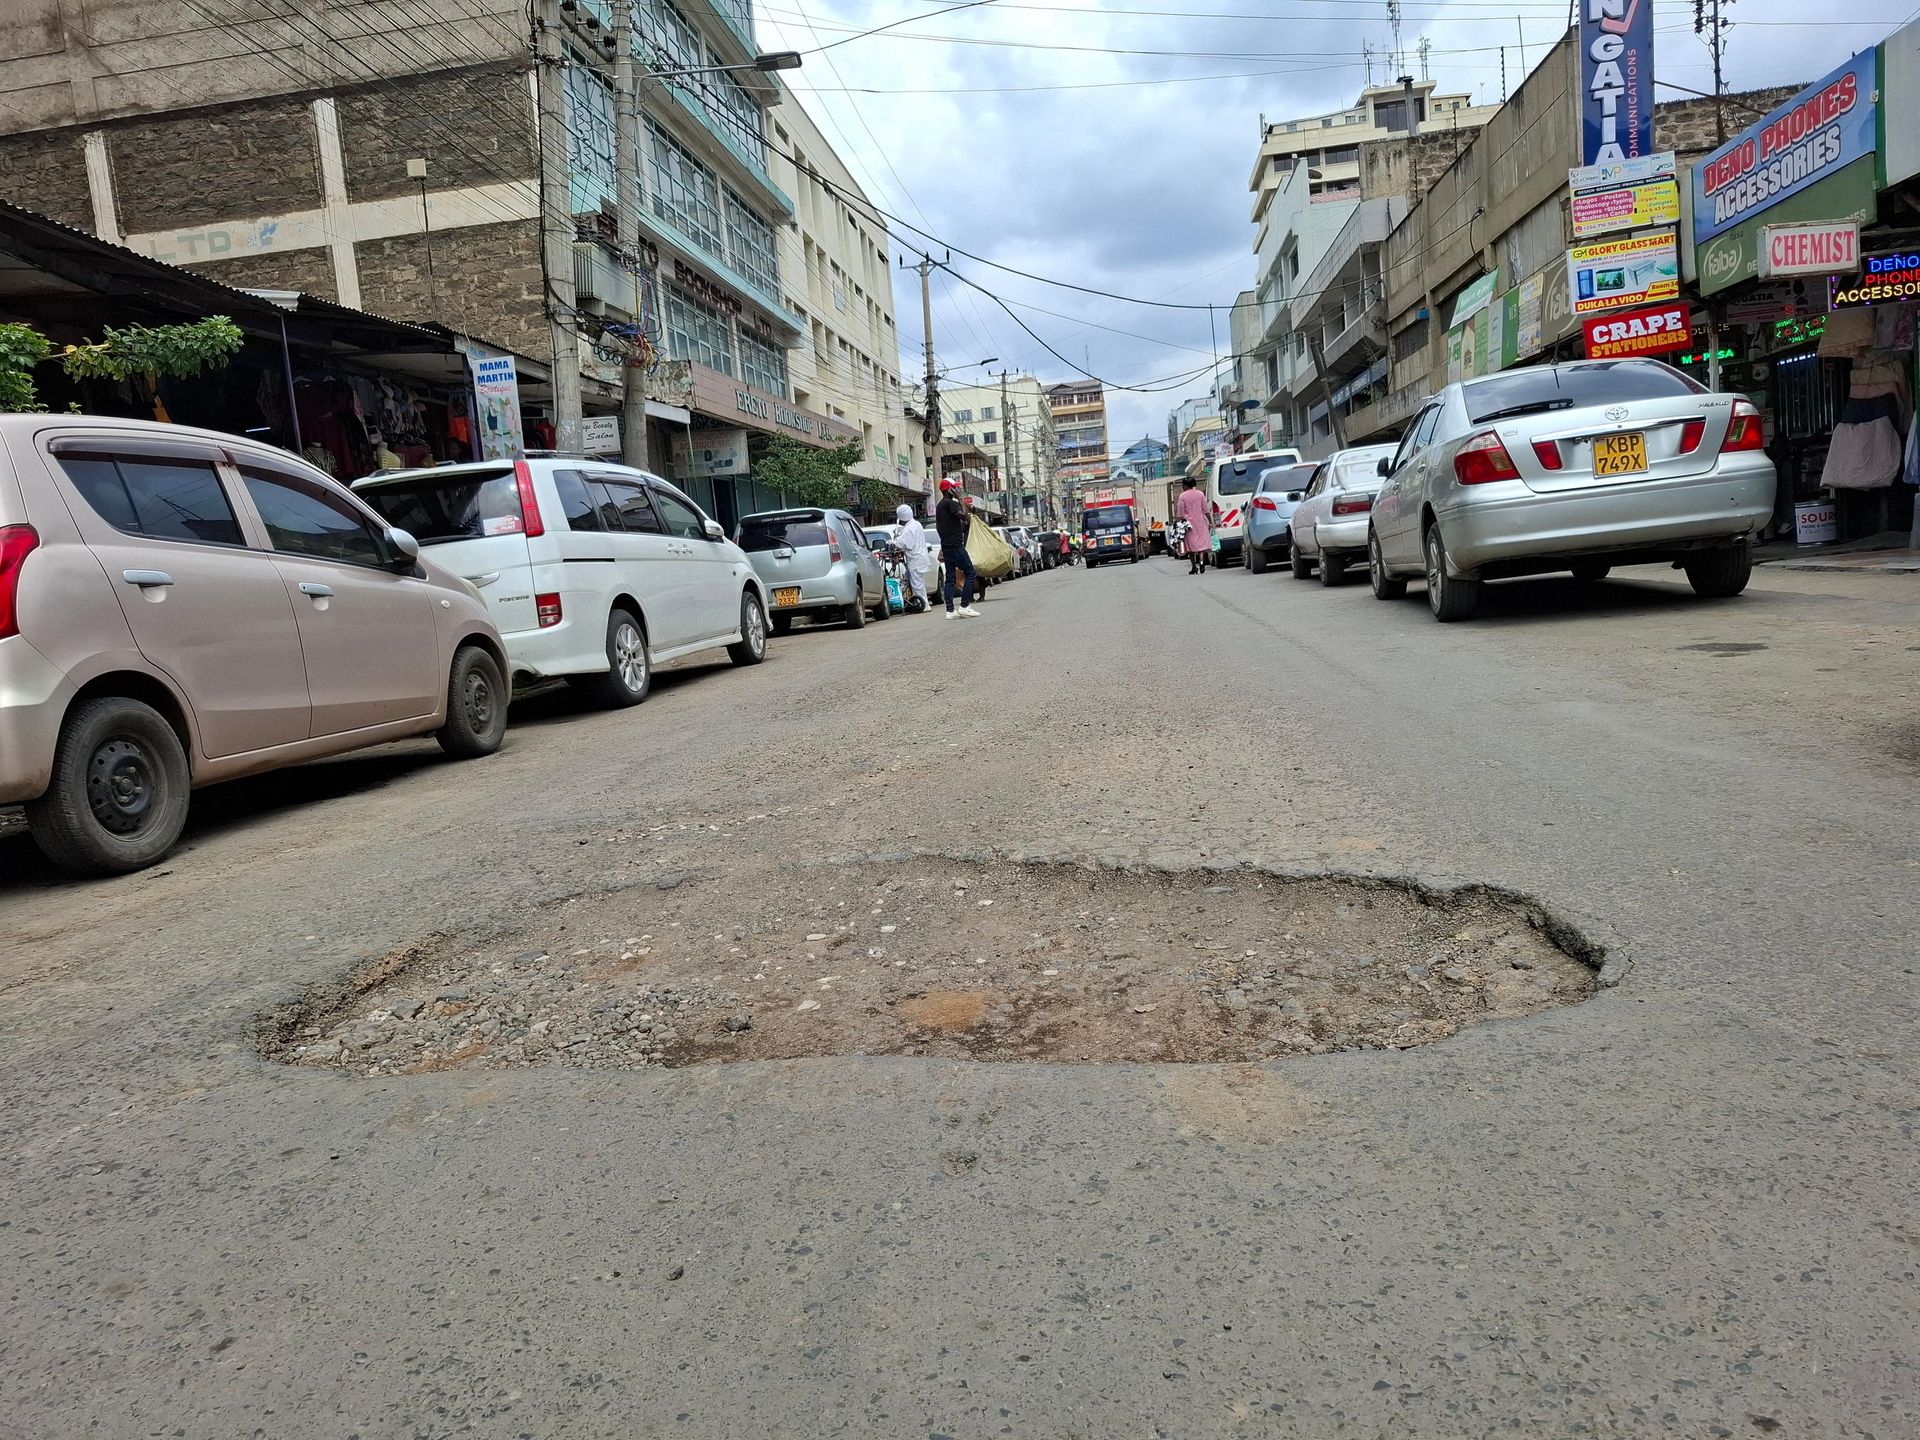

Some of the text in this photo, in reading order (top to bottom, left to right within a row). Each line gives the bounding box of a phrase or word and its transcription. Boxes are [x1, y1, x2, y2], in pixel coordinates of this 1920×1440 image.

[1626, 48, 1639, 159] OMMUNICATIONS
[1703, 72, 1857, 197] DENO PHONES
[1714, 125, 1841, 225] ACCESSORIES
[1576, 201, 1610, 211] Photocopy
[1579, 192, 1628, 205] Logos Posters
[1581, 213, 1609, 222] Business
[150, 230, 232, 261] LTD
[1588, 245, 1617, 257] GLORY
[1619, 240, 1648, 252] GLASS
[1649, 235, 1675, 247] MART
[1771, 230, 1855, 268] CHEMIST
[1870, 255, 1920, 273] DENO
[1836, 282, 1920, 304] ACCESSO
[1577, 301, 1602, 311] DUKA
[1604, 298, 1617, 307] LA
[1592, 311, 1683, 344] CRAPE
[1591, 329, 1688, 358] STATIONERS
[479, 360, 510, 372] MAMA
[477, 372, 514, 385] MARTIN
[480, 383, 512, 395] Boutique
[735, 388, 769, 420] ERETO
[773, 402, 813, 436] BOOKSHOP
[586, 431, 615, 441] Salon
[592, 421, 614, 430] Beauty
[1606, 434, 1640, 456] KBP
[1598, 453, 1643, 475] 749X
